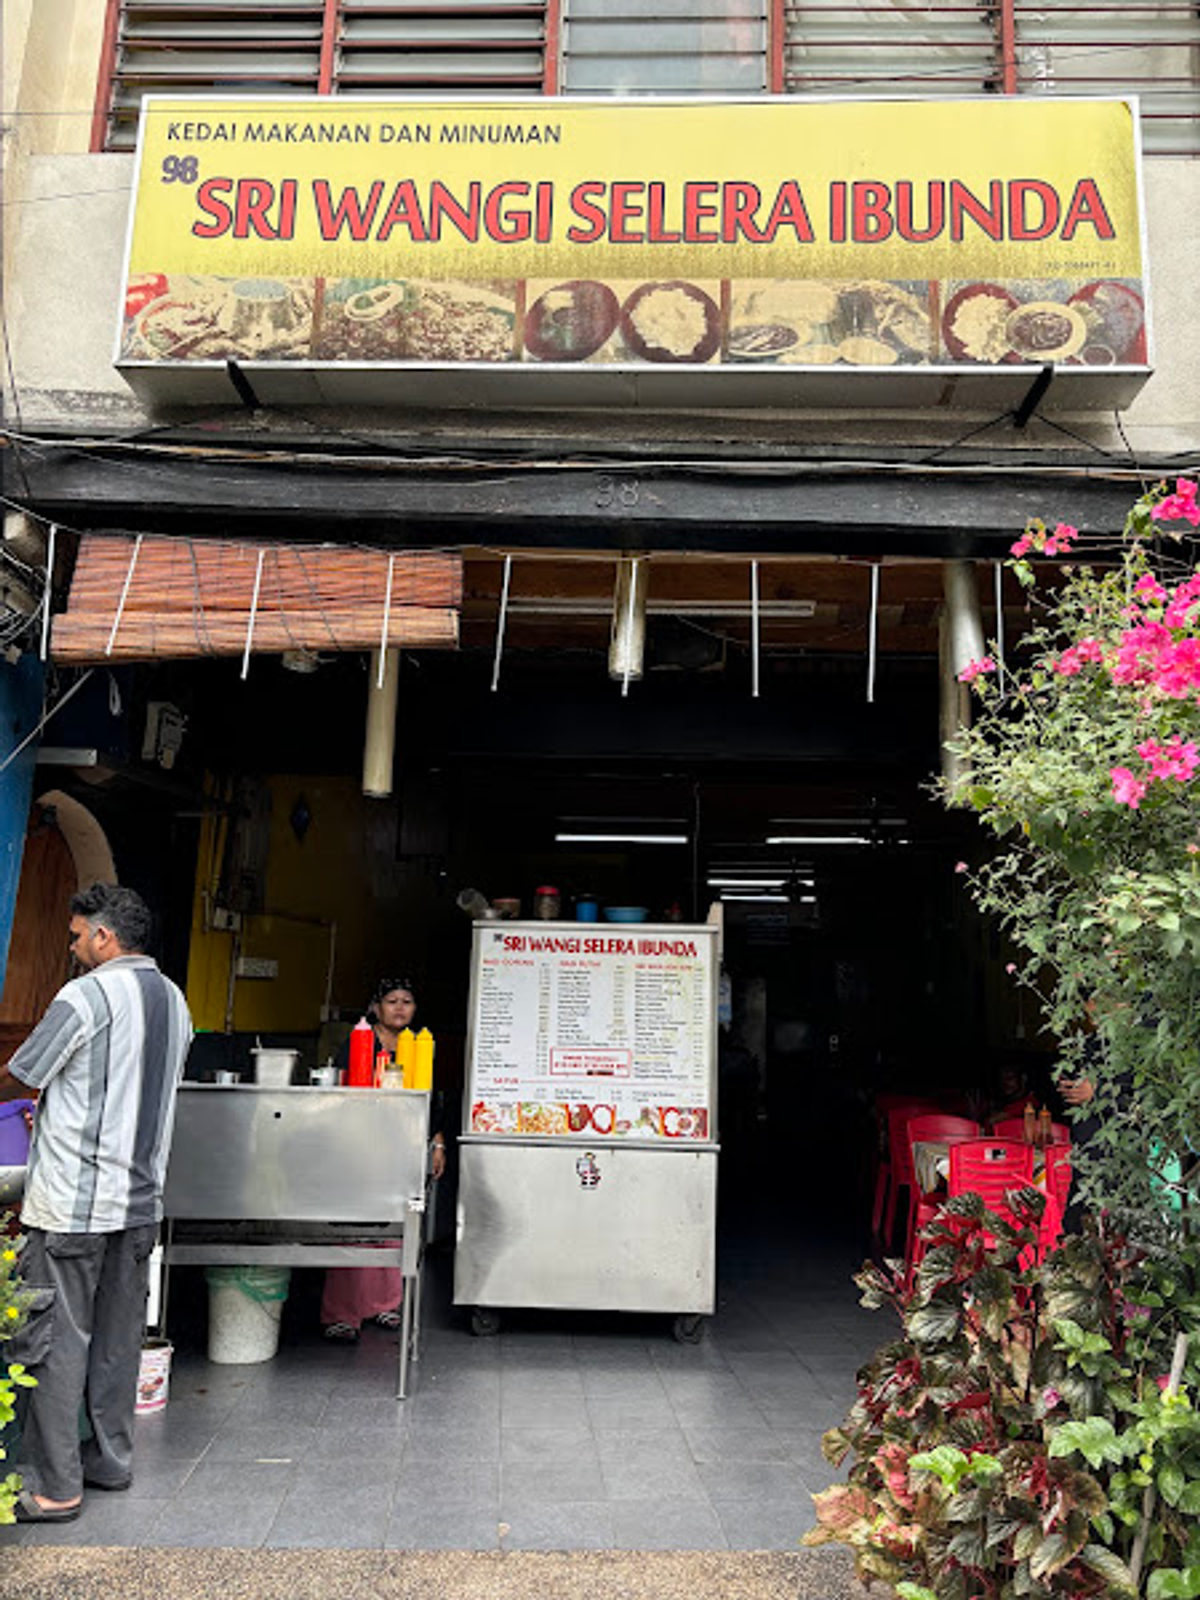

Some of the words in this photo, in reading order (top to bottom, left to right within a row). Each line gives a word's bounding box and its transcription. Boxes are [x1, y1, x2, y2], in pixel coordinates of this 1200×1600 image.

[167, 122, 236, 142] KEDAI
[244, 123, 371, 144] MAKANAN
[379, 124, 432, 144] DAN
[439, 124, 562, 145] MINUMAN
[161, 154, 199, 185] 98
[191, 177, 298, 240] SRI
[312, 178, 554, 244] WANGI
[567, 179, 816, 244] SELERA
[829, 177, 1117, 244] IBUNDA
[503, 934, 526, 951] SRI
[528, 936, 581, 954] WANGI
[583, 937, 636, 956] SELERA
[637, 939, 698, 958] IBUNDA
